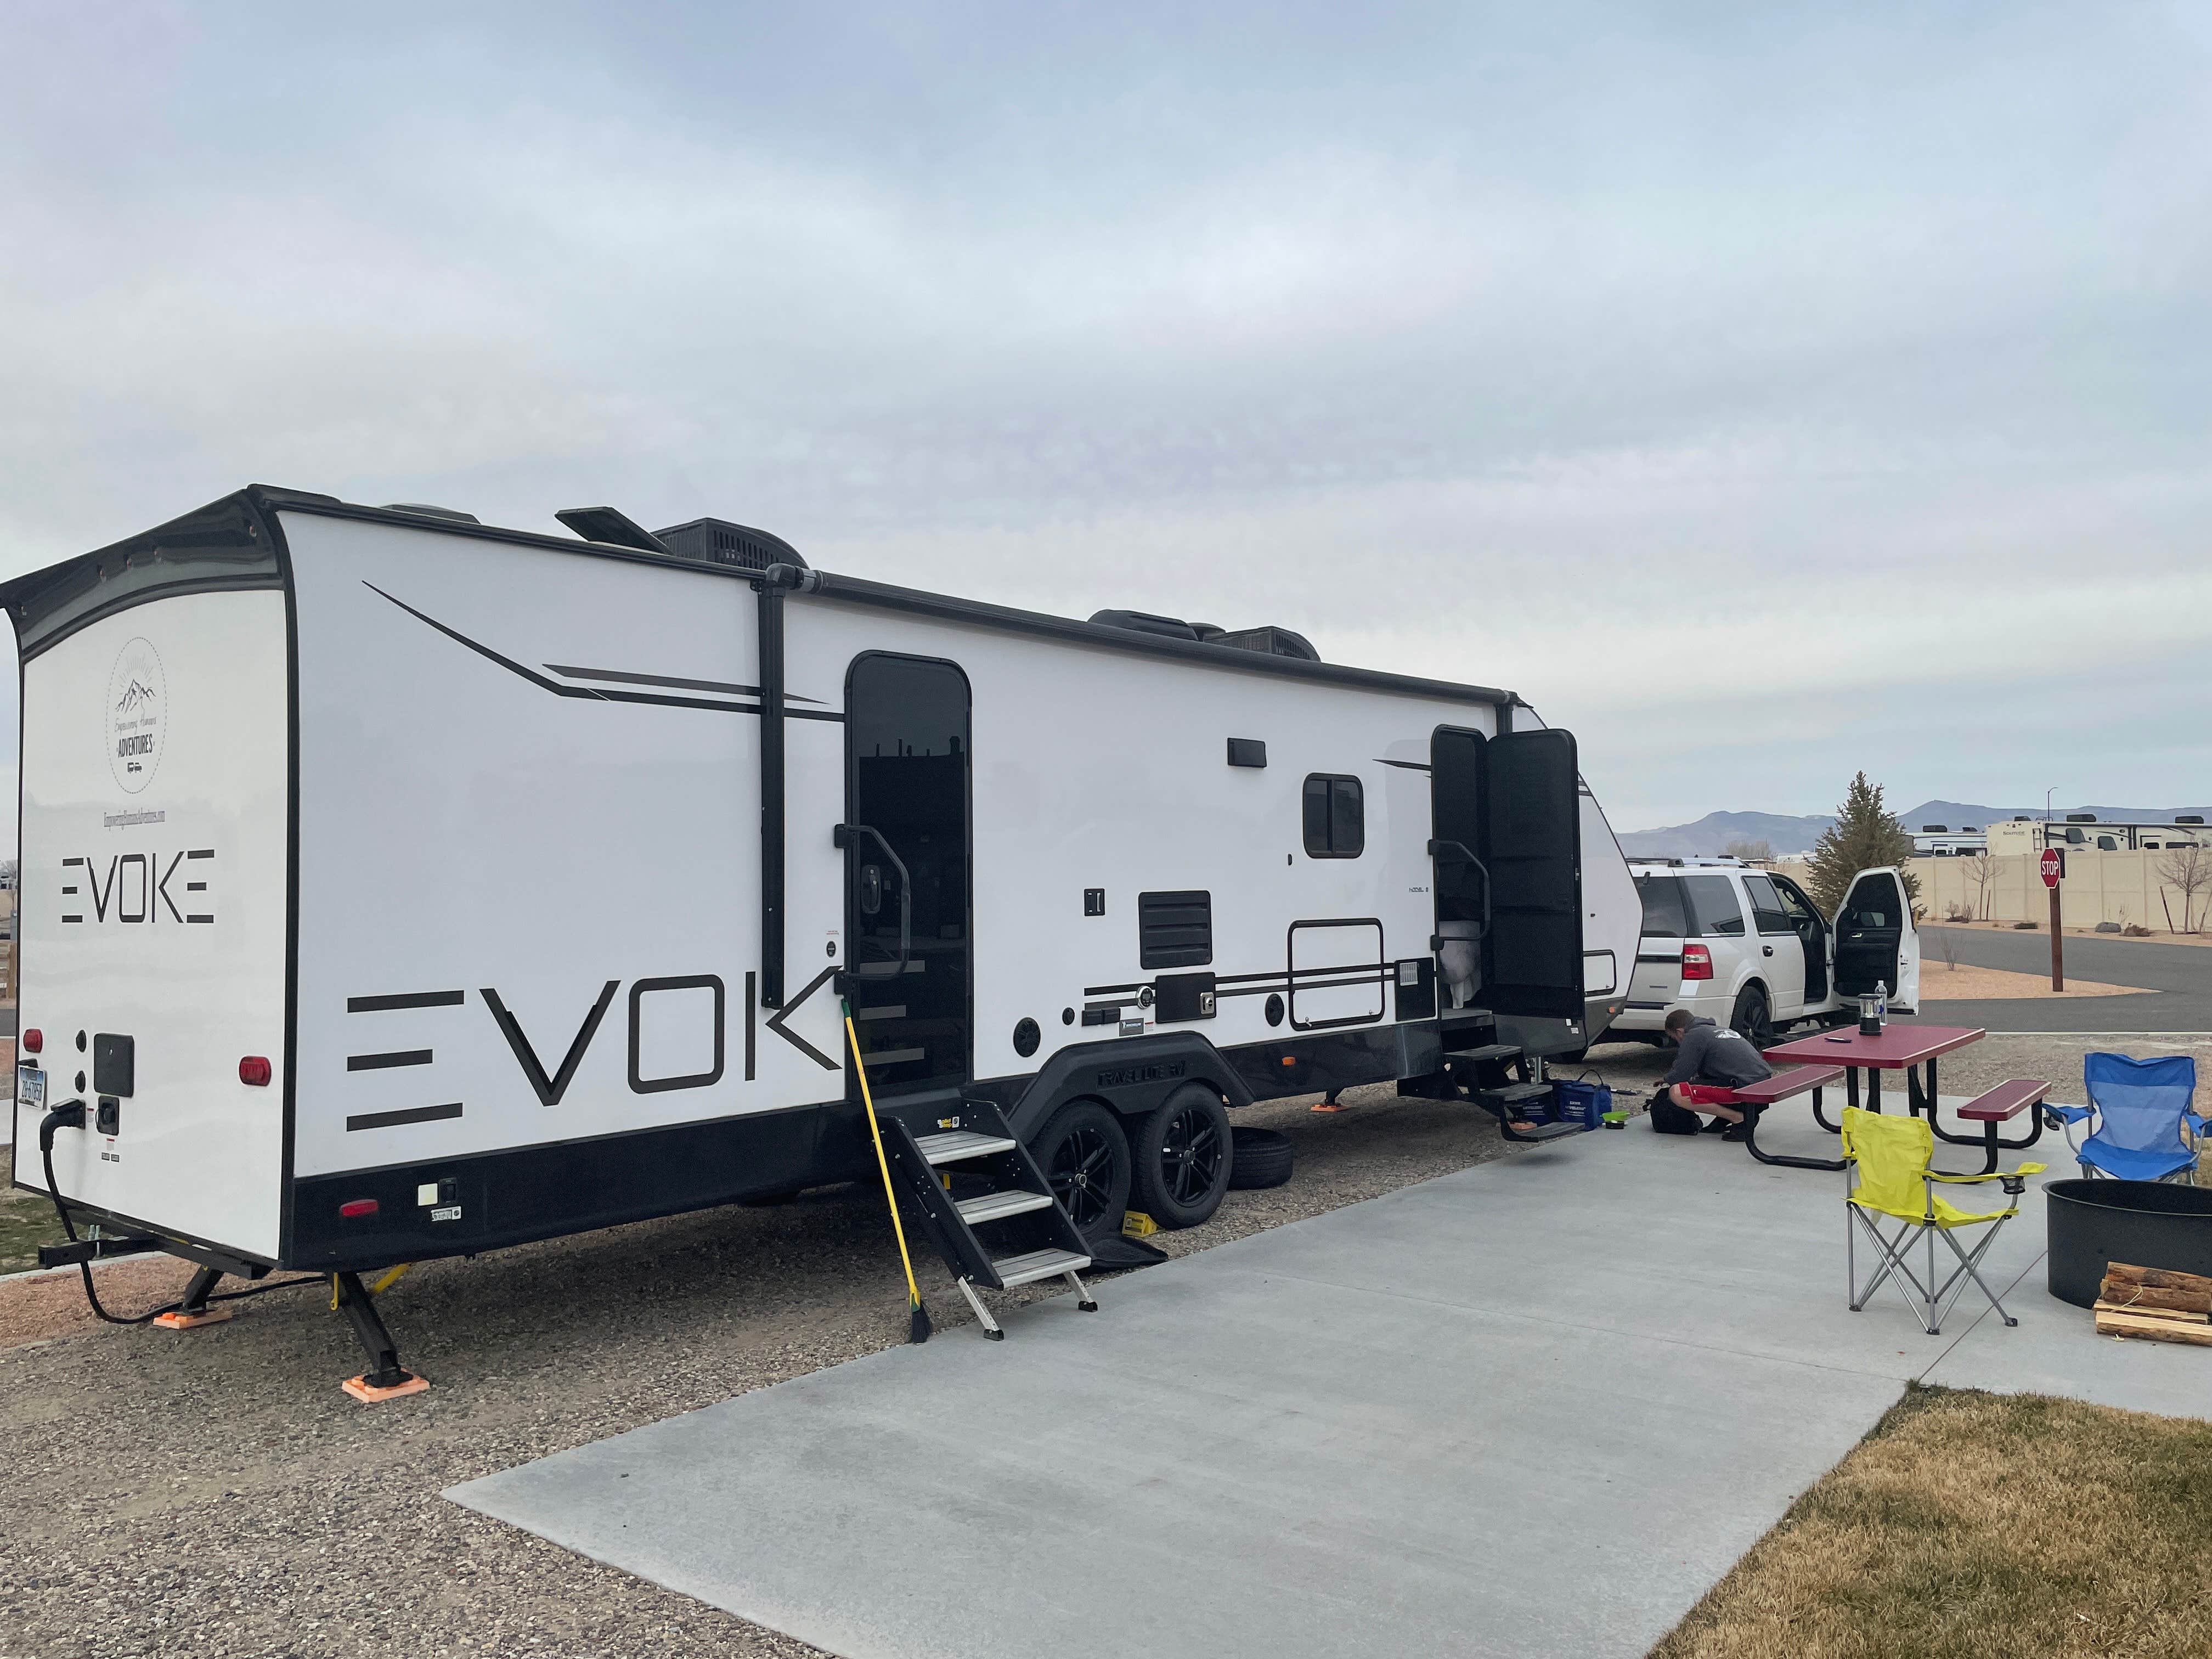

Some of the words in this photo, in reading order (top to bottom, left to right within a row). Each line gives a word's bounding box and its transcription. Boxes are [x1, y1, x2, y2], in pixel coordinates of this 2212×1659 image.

[118, 733, 153, 758] ADVENTURES
[2041, 860, 2059, 876] STOP
[62, 849, 215, 923] EVOKE
[1098, 1068, 1142, 1086] TRAVEL
[1169, 1060, 1186, 1077] RV
